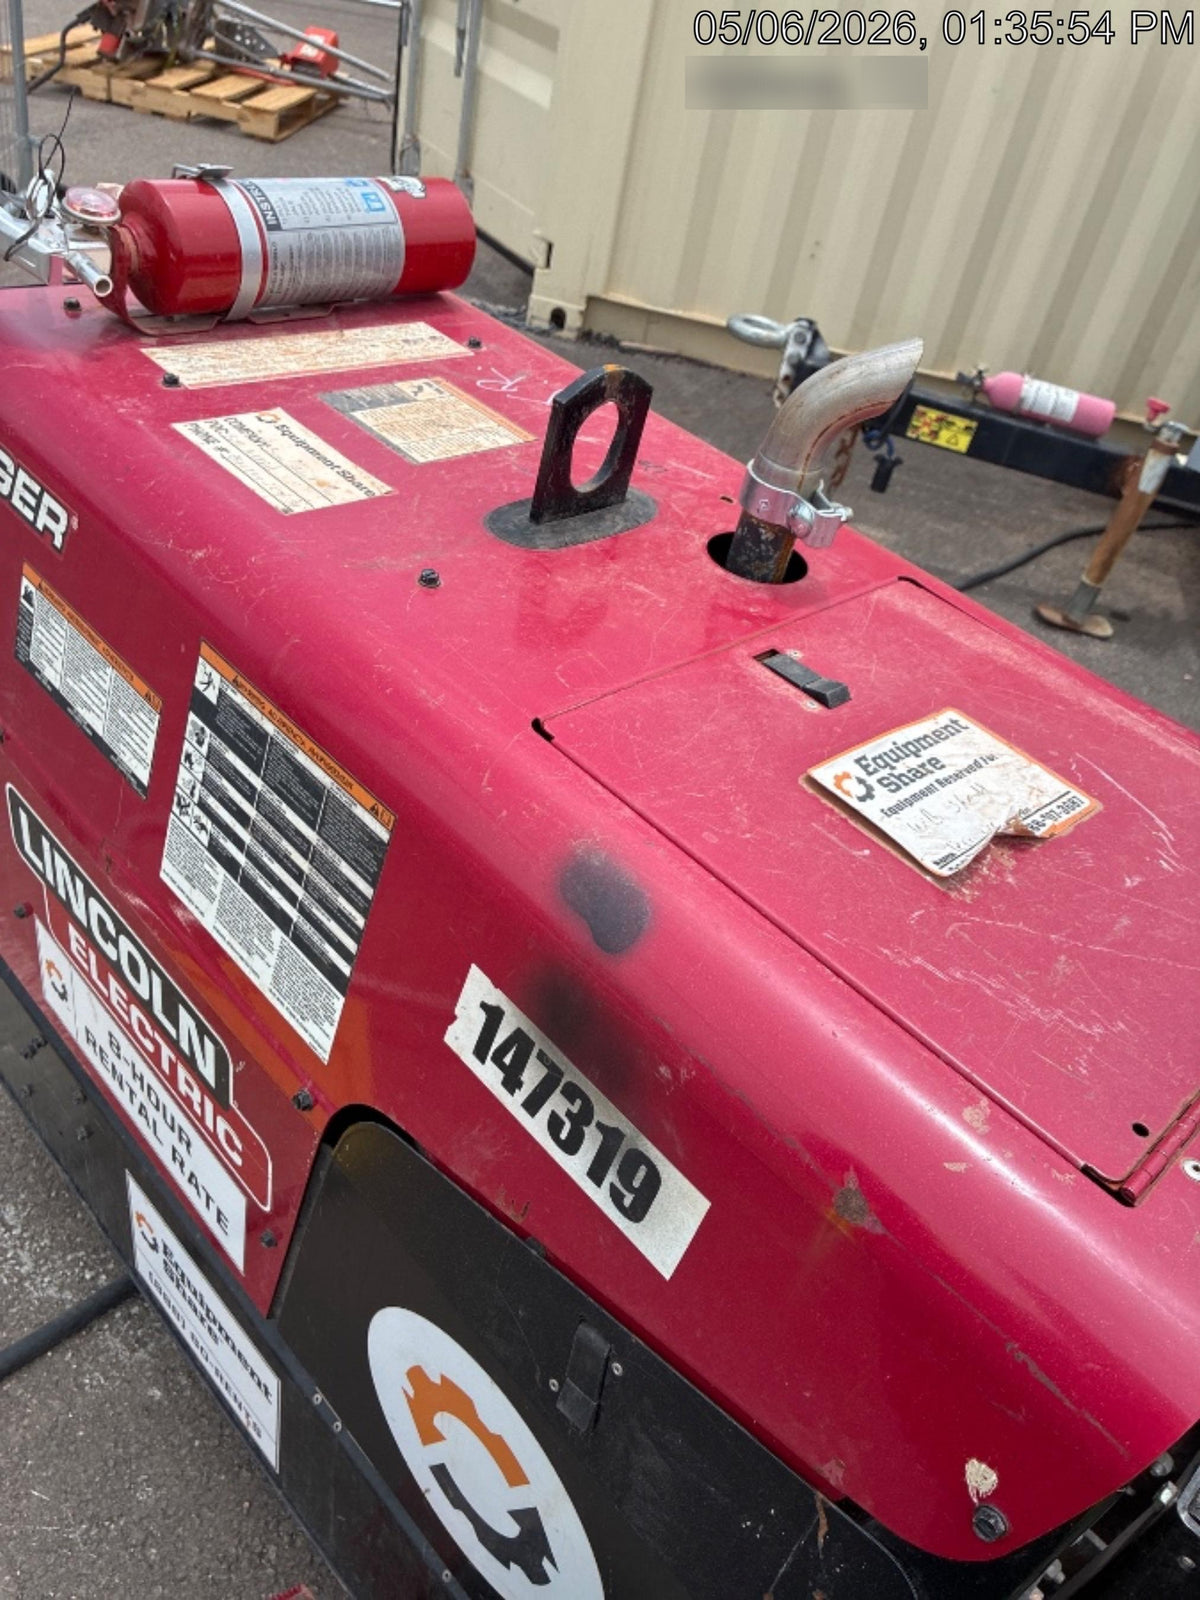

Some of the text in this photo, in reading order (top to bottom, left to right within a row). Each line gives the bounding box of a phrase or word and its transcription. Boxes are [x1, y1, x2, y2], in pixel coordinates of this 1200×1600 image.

[854, 717, 969, 777] Equipment
[876, 756, 946, 794] Share
[19, 806, 216, 1089] LINCOLN
[68, 921, 243, 1167] ELECTRIC
[108, 1030, 193, 1157] 8-HOUR
[472, 1000, 662, 1223] 147319
[84, 1026, 230, 1237] RENTAL RATE
[161, 1237, 273, 1405] Equipment
[163, 1257, 220, 1346] Share
